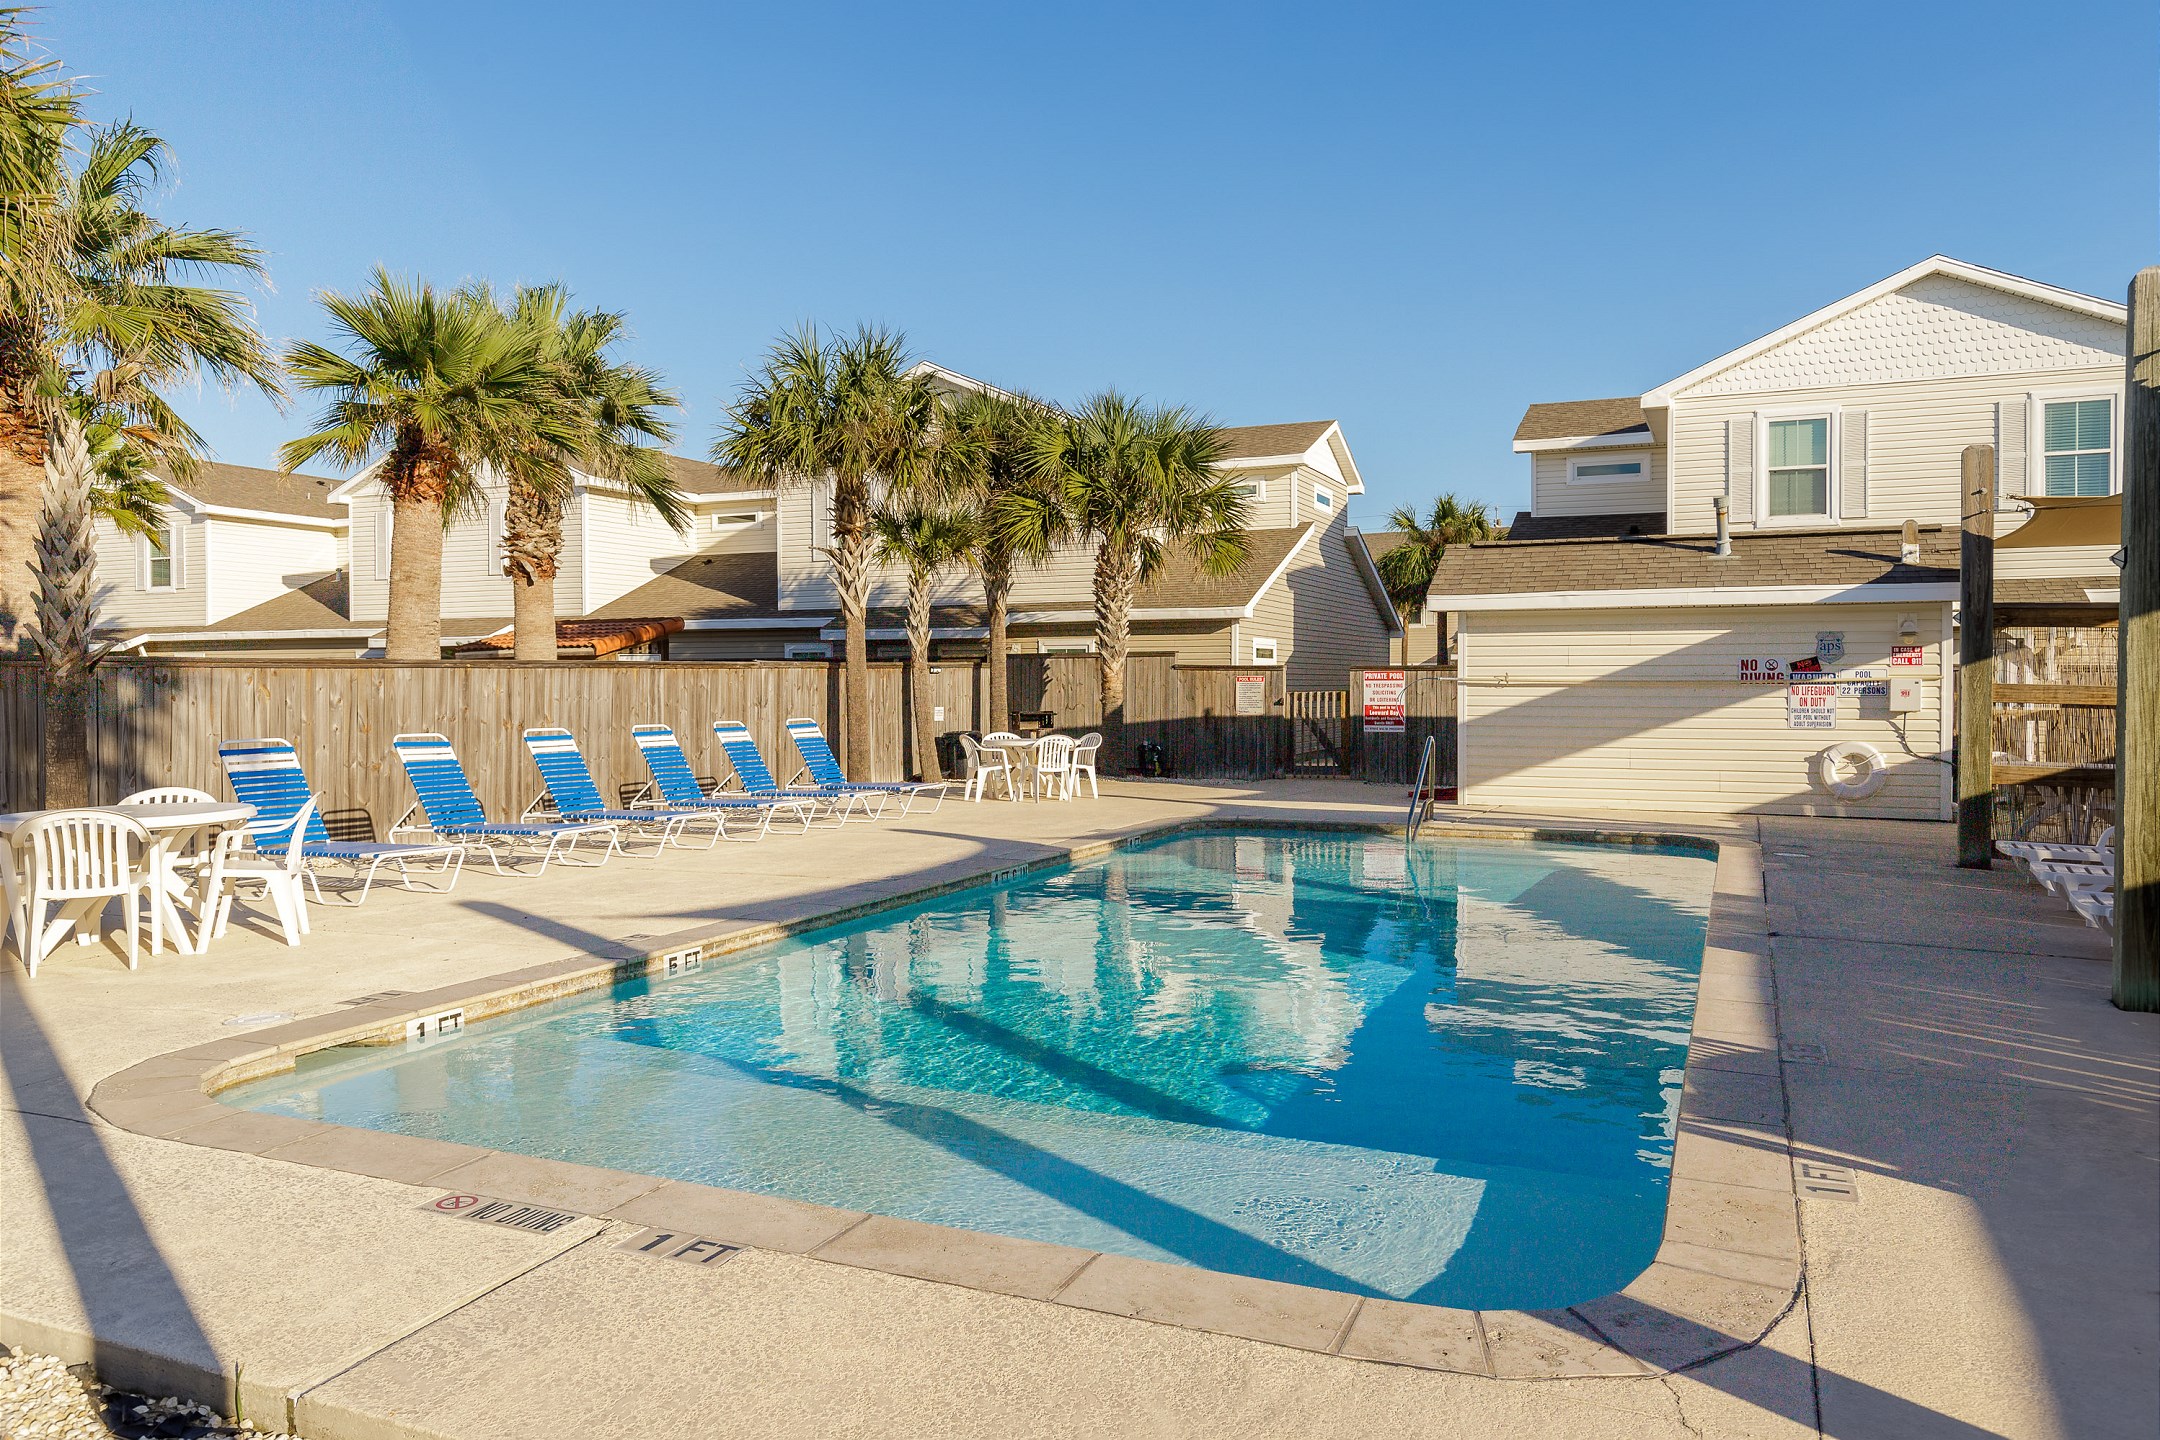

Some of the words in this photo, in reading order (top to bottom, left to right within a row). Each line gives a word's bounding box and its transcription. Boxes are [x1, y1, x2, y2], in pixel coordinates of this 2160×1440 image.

[1820, 642, 1841, 653] aps
[1741, 659, 1758, 671] NO
[1741, 672, 1784, 684] DIVING
[1791, 686, 1800, 696] NO
[1802, 686, 1835, 696] LIFEGUARD
[1842, 687, 1851, 695] 22
[1854, 687, 1886, 695] PERSONS
[1799, 697, 1808, 707] ON
[1811, 697, 1826, 707] DUTY
[668, 956, 678, 969] 5
[685, 951, 700, 965] FT
[417, 1022, 425, 1037] 1
[438, 1012, 461, 1032] FT
[1801, 1163, 1848, 1183] FT
[1805, 1186, 1850, 1195] 1
[466, 1202, 513, 1220] NO
[495, 1207, 575, 1232] DIVING
[638, 1234, 675, 1251] 1
[673, 1240, 741, 1263] FT
